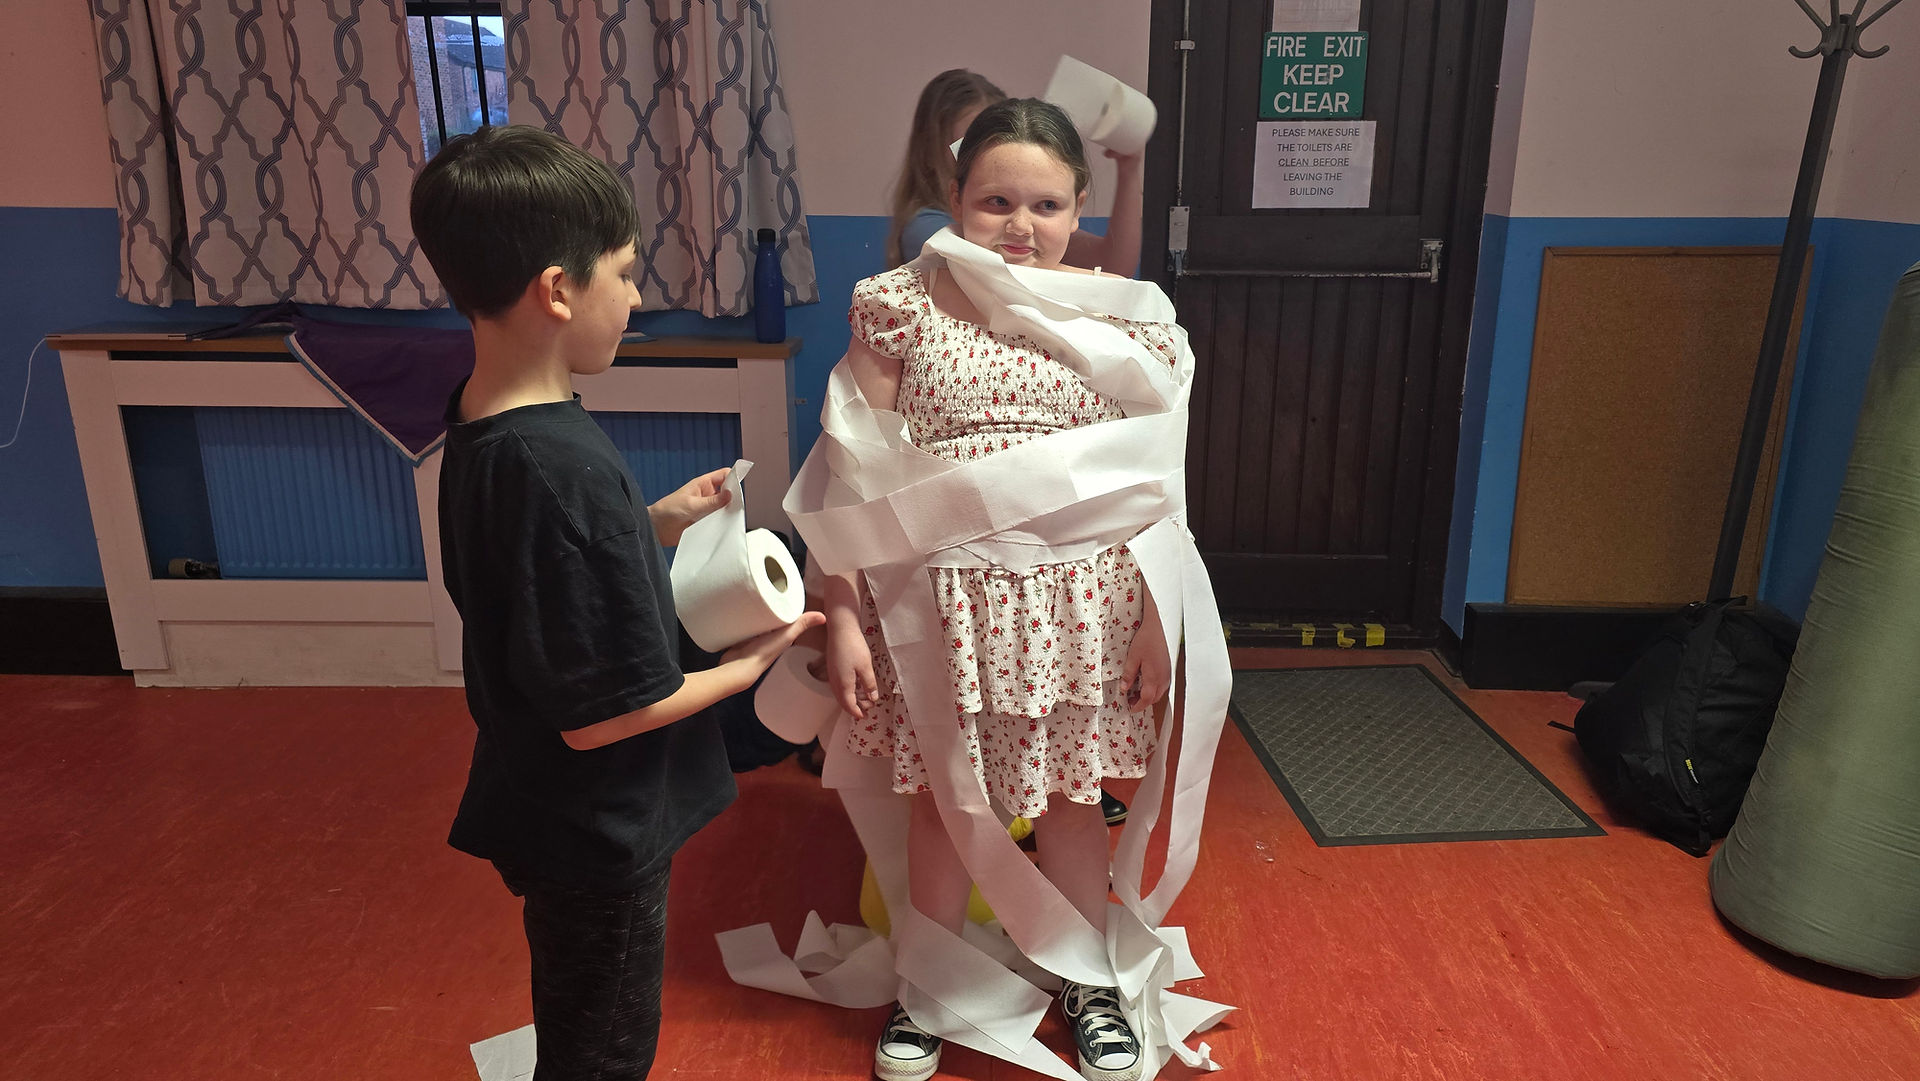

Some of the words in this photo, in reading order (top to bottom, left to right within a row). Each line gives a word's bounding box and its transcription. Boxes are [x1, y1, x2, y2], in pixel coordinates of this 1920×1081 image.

[1266, 36, 1307, 57] FIRE
[1323, 36, 1364, 57] EXIT
[1283, 64, 1344, 85] KEEP
[1273, 92, 1349, 113] CLEAR
[1272, 128, 1306, 137] PLEASE
[1308, 128, 1334, 136] MAKE
[1335, 128, 1360, 136] SURE
[1277, 144, 1295, 152] THE
[1297, 144, 1332, 152] TOILETS
[1334, 143, 1352, 151] ARE
[1278, 158, 1309, 166] CLEAN
[1313, 158, 1350, 166] BEFORE
[1283, 173, 1323, 181] LEAVING
[1289, 188, 1334, 196] BUILDING
